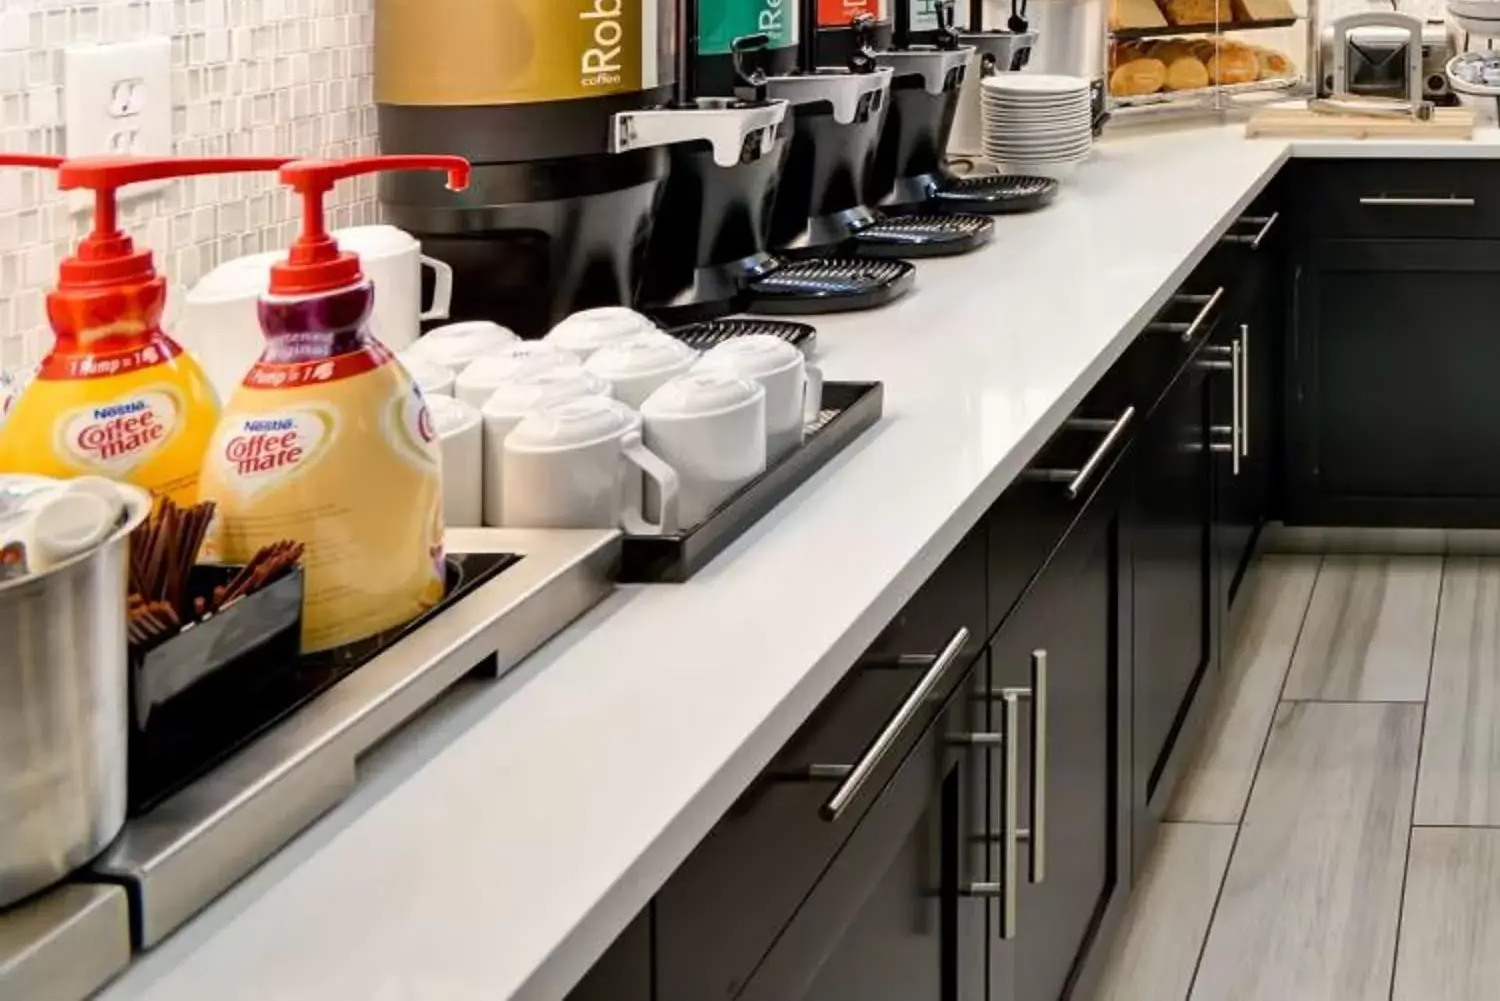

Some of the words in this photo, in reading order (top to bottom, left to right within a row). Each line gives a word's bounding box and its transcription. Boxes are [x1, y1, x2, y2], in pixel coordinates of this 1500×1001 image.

[78, 410, 155, 451] Coffee
[100, 422, 163, 460] mate
[225, 432, 297, 464] Coffee
[237, 448, 303, 477] mate
